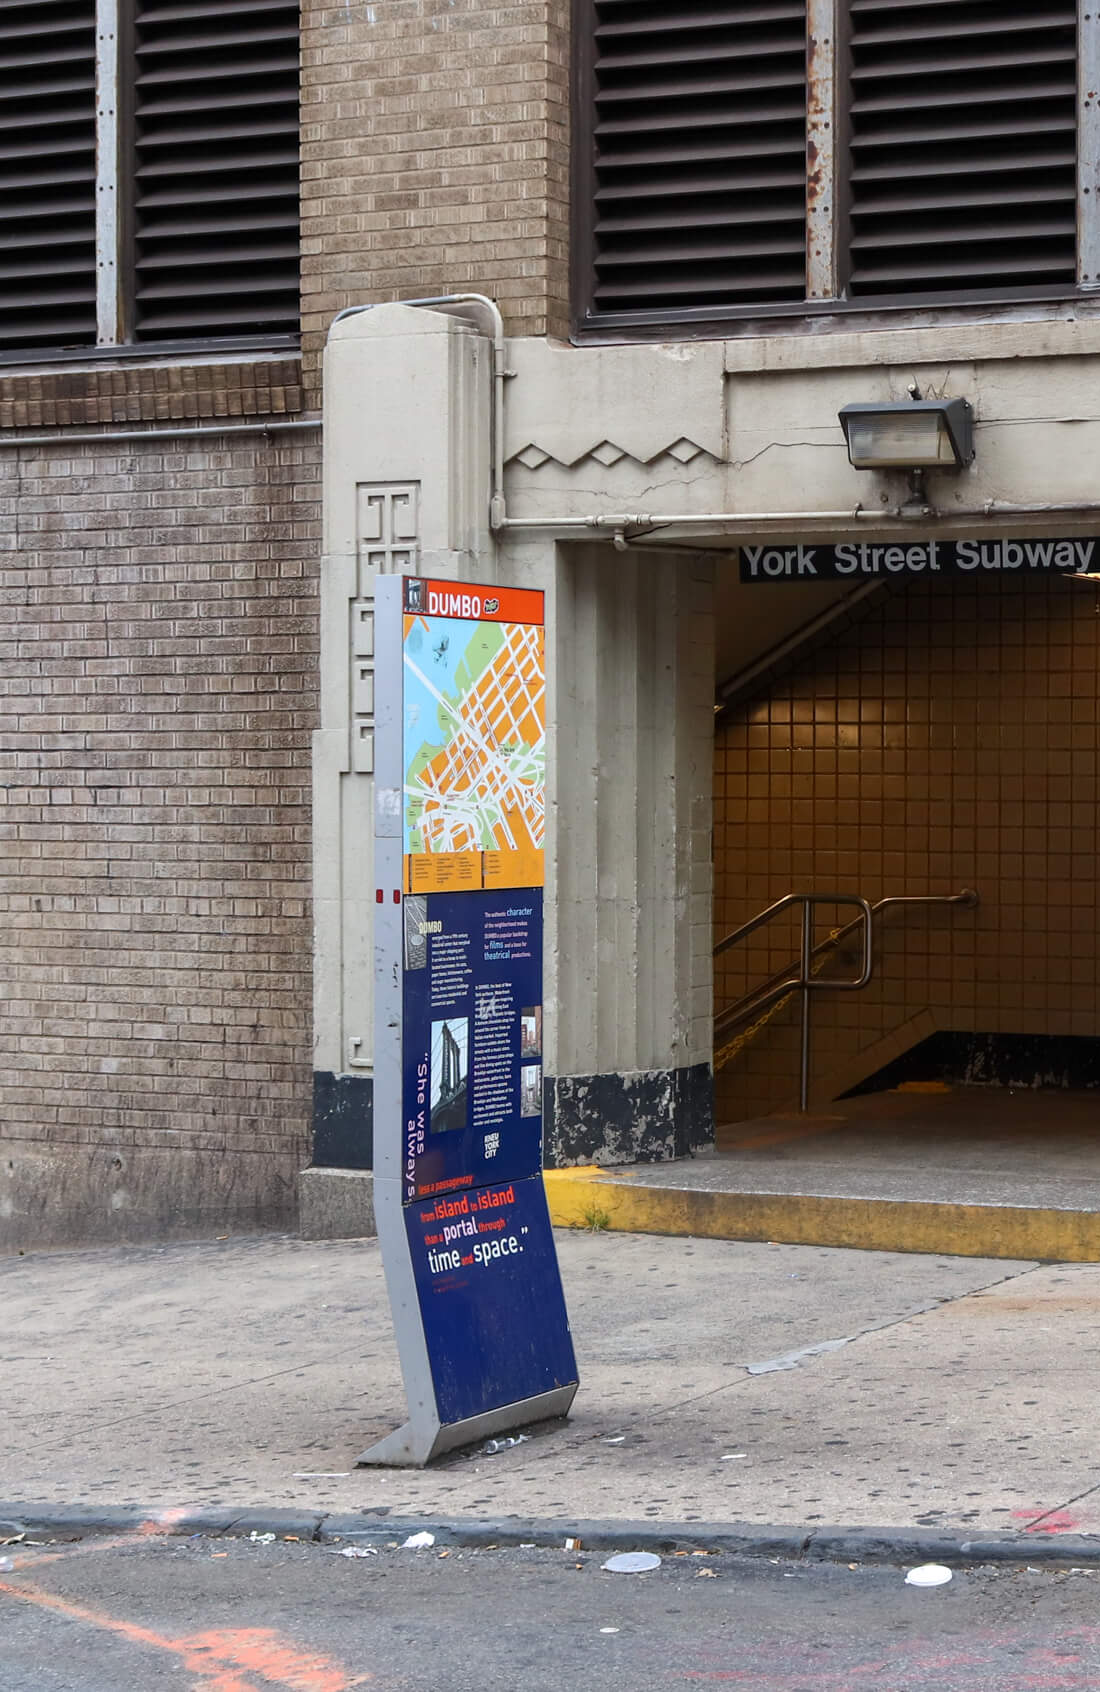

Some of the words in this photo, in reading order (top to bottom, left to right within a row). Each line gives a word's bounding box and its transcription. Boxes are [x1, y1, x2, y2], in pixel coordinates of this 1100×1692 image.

[742, 544, 818, 576] York
[834, 540, 941, 573] Street
[955, 539, 1096, 574] Subway
[429, 592, 481, 618] DUMBO
[506, 907, 533, 917] character
[484, 950, 510, 961] theatrical
[489, 940, 504, 949] films
[416, 1111, 425, 1154] was
[484, 1140, 500, 1151] YORK
[405, 1119, 416, 1197] always
[484, 1149, 497, 1160] CITY
[435, 1174, 474, 1192] passageway
[433, 1195, 469, 1219] island
[477, 1185, 515, 1210] island
[442, 1216, 479, 1246] portal
[478, 1217, 506, 1233] through
[428, 1247, 461, 1274] time
[461, 1253, 474, 1266] and
